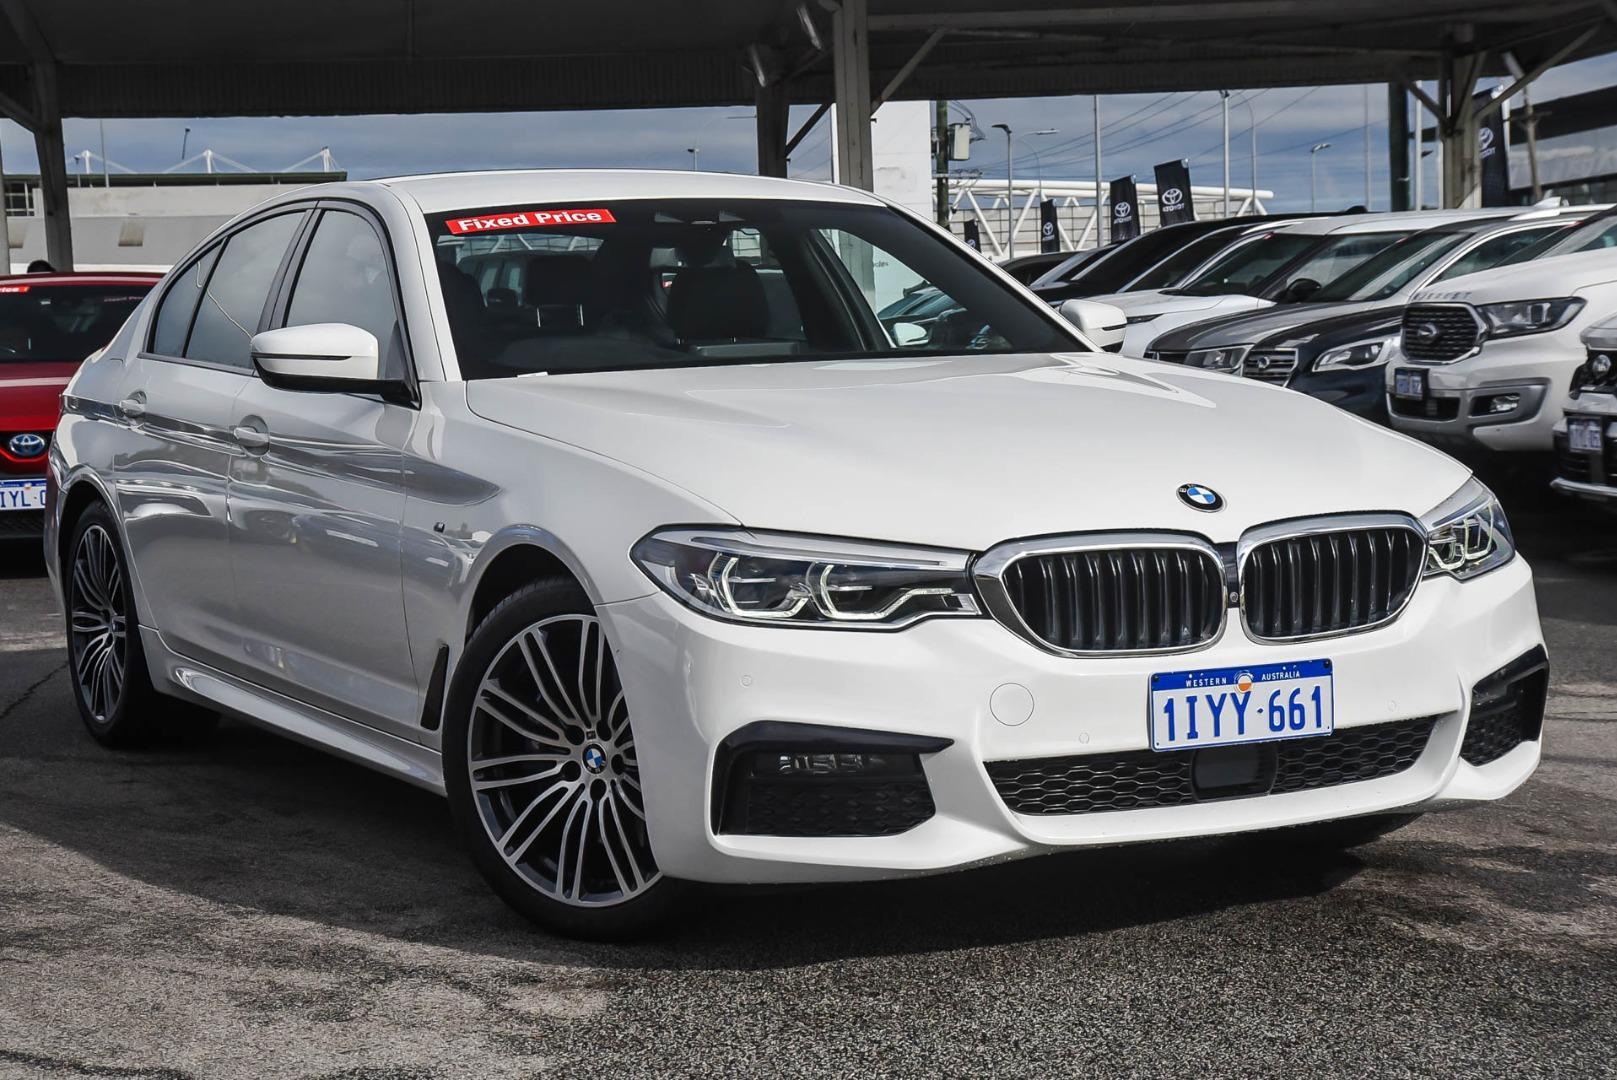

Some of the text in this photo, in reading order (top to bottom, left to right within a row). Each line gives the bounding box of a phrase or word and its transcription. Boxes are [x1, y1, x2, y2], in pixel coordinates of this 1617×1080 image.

[457, 211, 603, 232] Fixed Price
[1185, 670, 1301, 688] WESTERN AUSTRALIA
